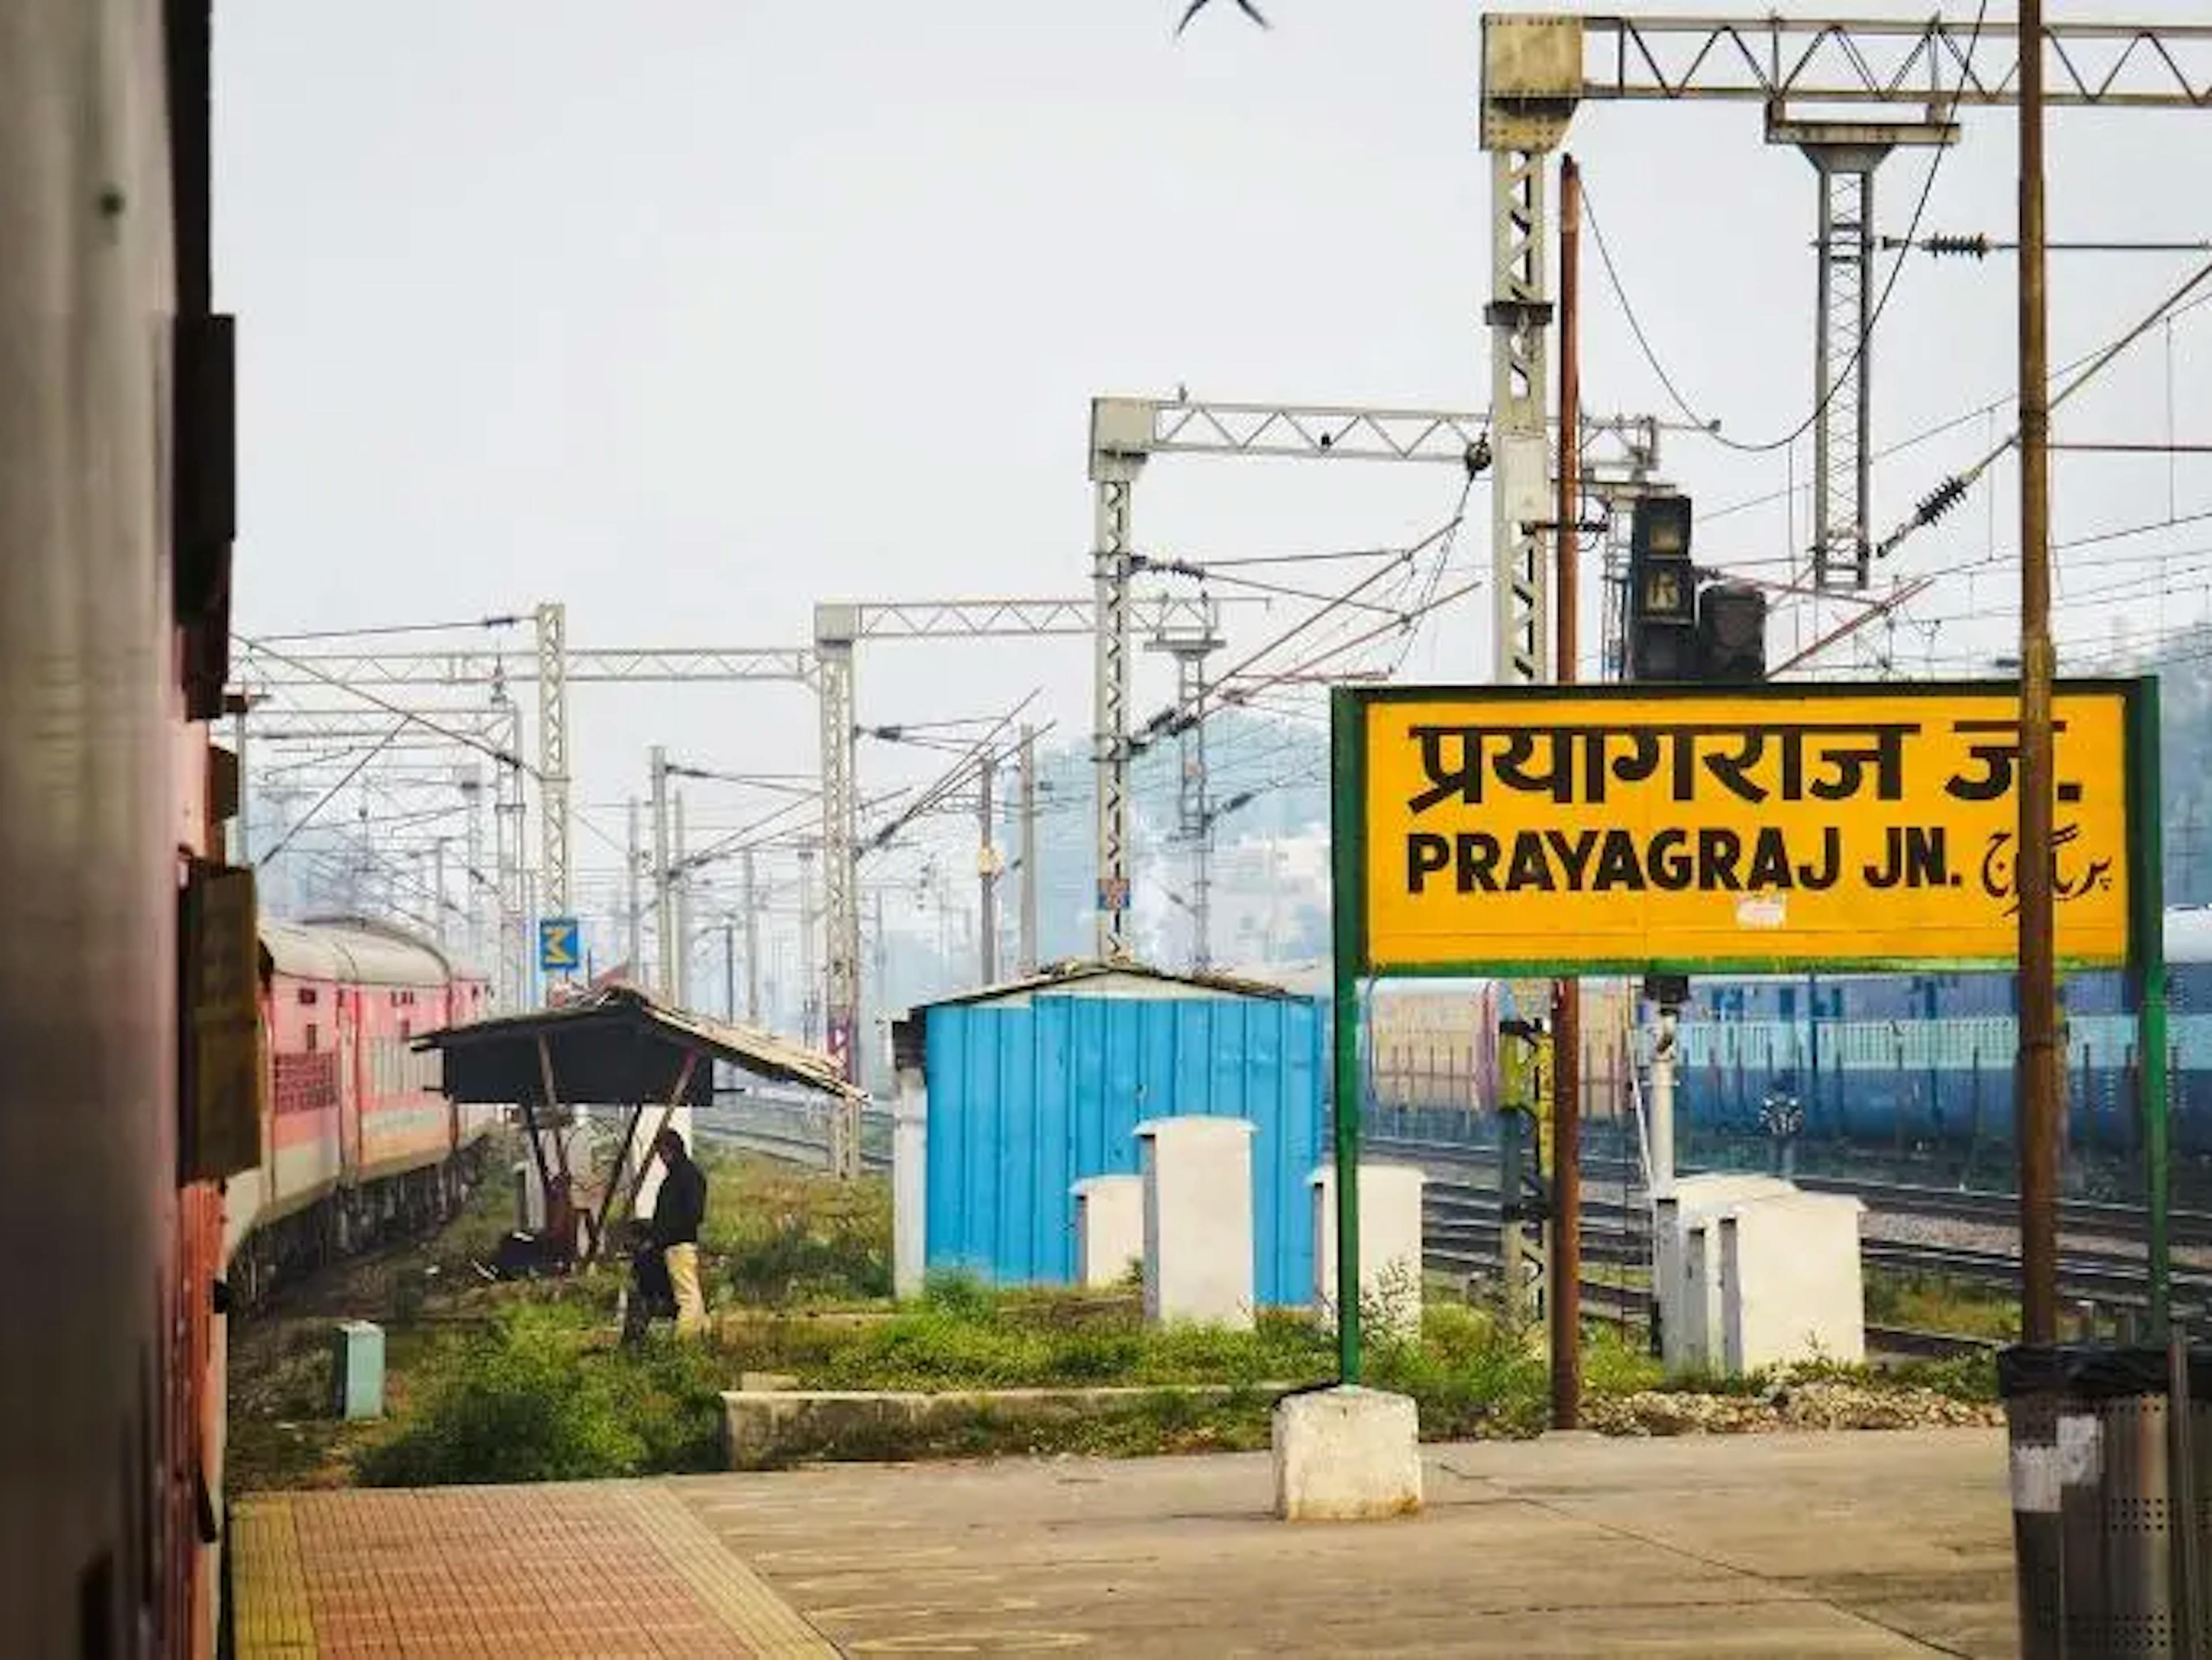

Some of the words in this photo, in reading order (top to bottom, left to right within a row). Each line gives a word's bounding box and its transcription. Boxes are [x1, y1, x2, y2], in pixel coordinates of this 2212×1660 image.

[1407, 723, 1921, 814] प्रयागराज
[1407, 826, 1840, 893] PRAYAGRAJ
[1863, 826, 1962, 888] JN.
